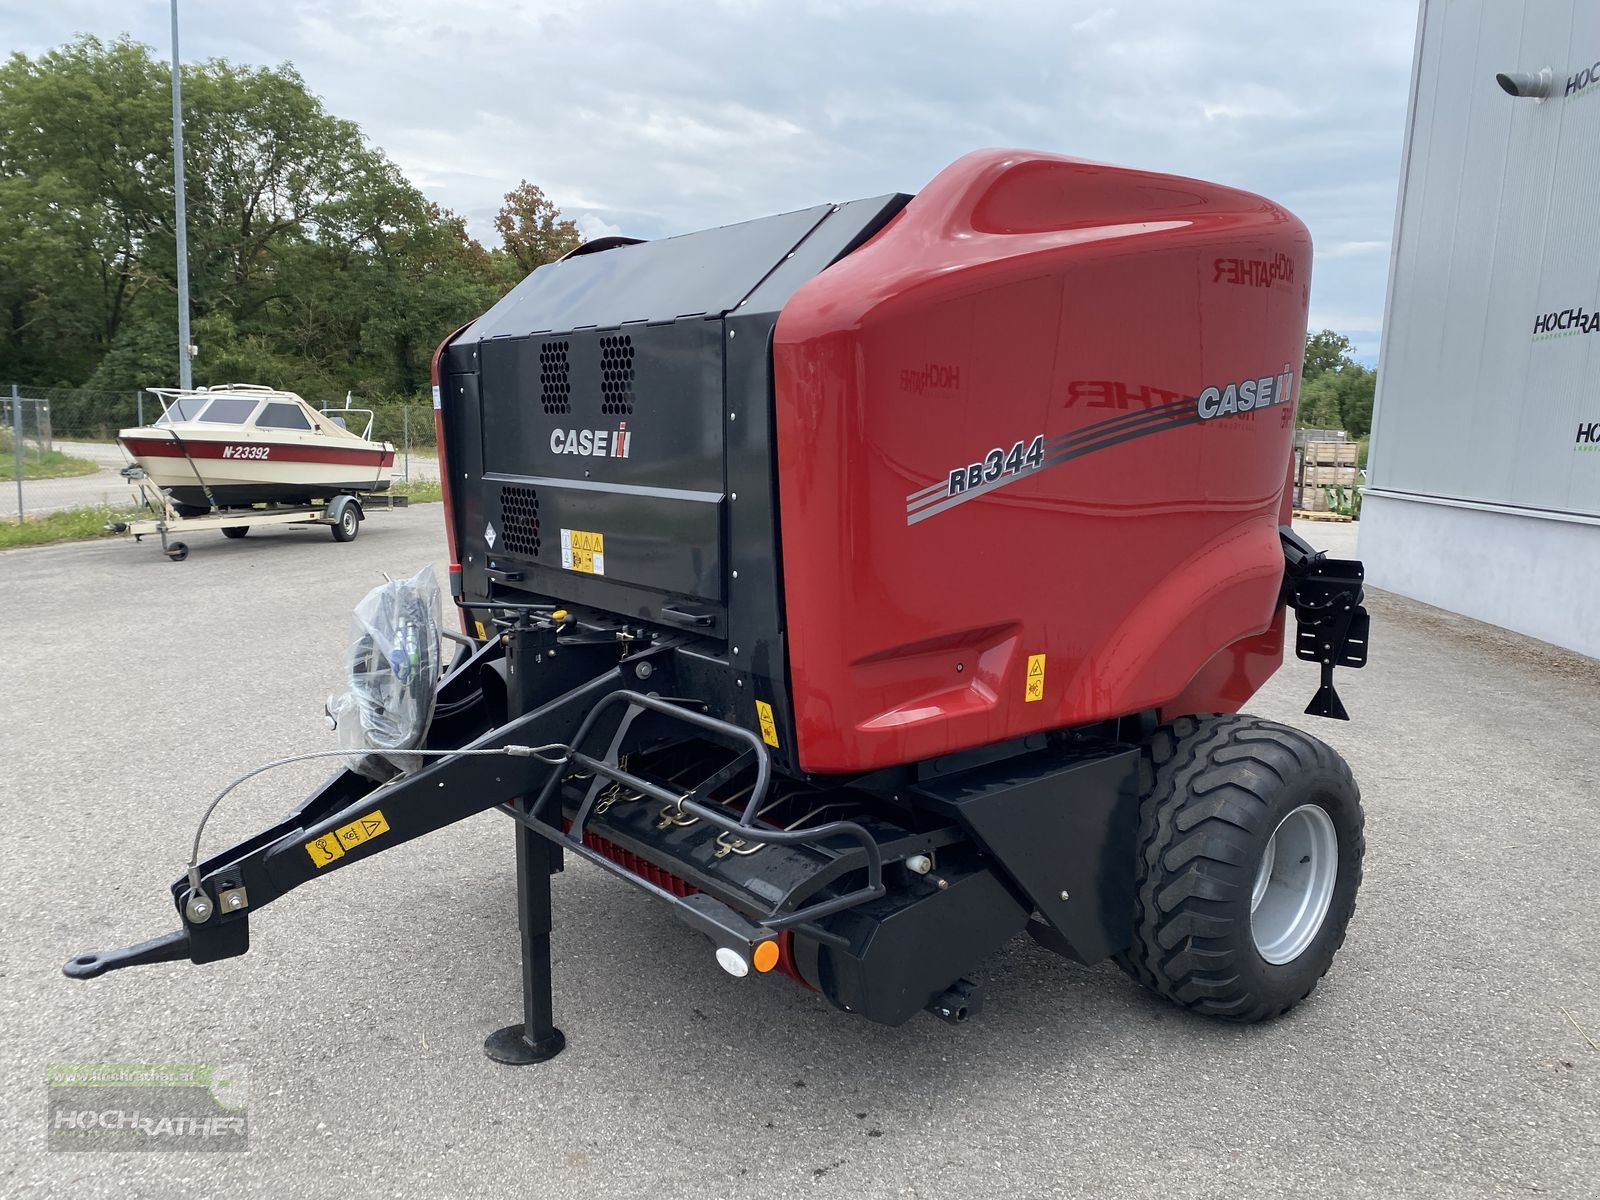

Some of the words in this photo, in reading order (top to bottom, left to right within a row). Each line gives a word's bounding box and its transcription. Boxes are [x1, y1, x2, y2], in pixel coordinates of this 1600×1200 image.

[1198, 377, 1274, 419] CASE
[222, 445, 270, 460] N-23392
[550, 428, 608, 457] CASE
[947, 434, 1045, 497] RB344
